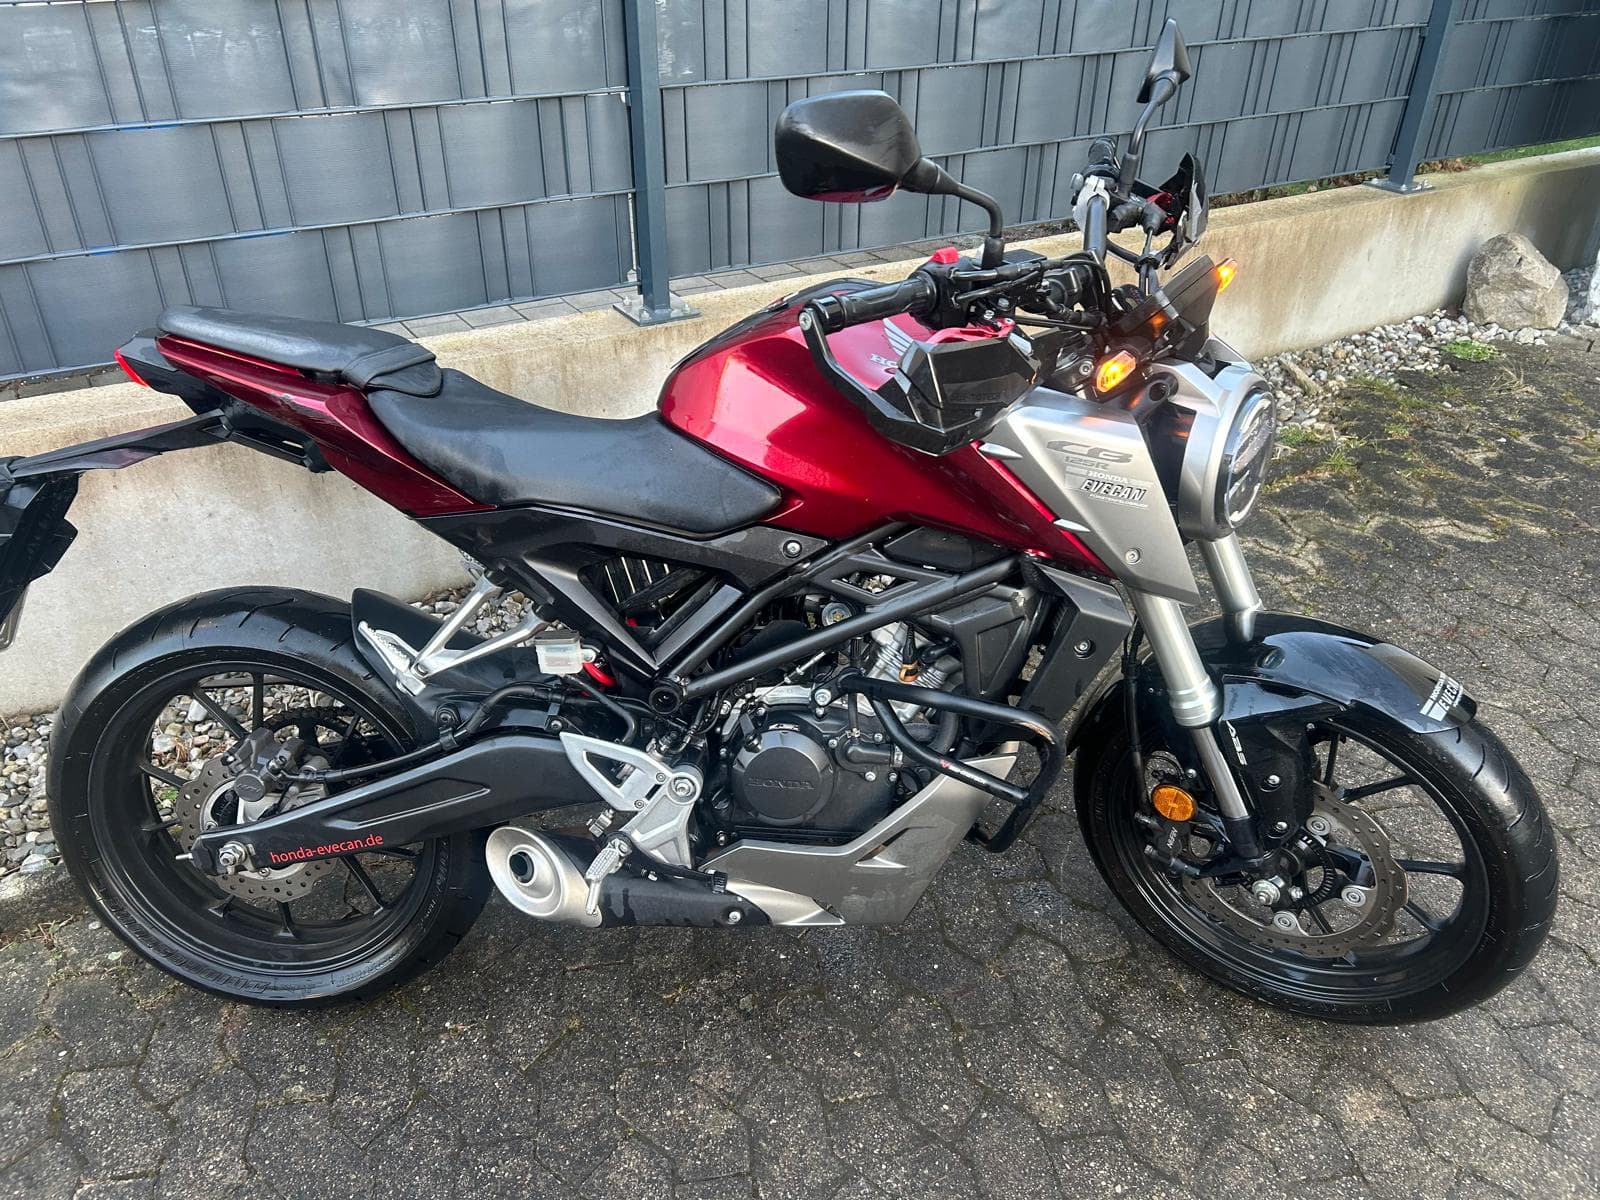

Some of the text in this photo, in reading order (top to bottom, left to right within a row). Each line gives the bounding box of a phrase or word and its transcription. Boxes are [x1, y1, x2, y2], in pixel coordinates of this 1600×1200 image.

[1046, 440, 1134, 464] CB
[1064, 455, 1111, 470] 125R
[1087, 470, 1128, 484] HONDA
[1080, 478, 1147, 501] EVECAN
[747, 777, 816, 790] HONDA
[270, 833, 384, 864] honda-evecan.de
